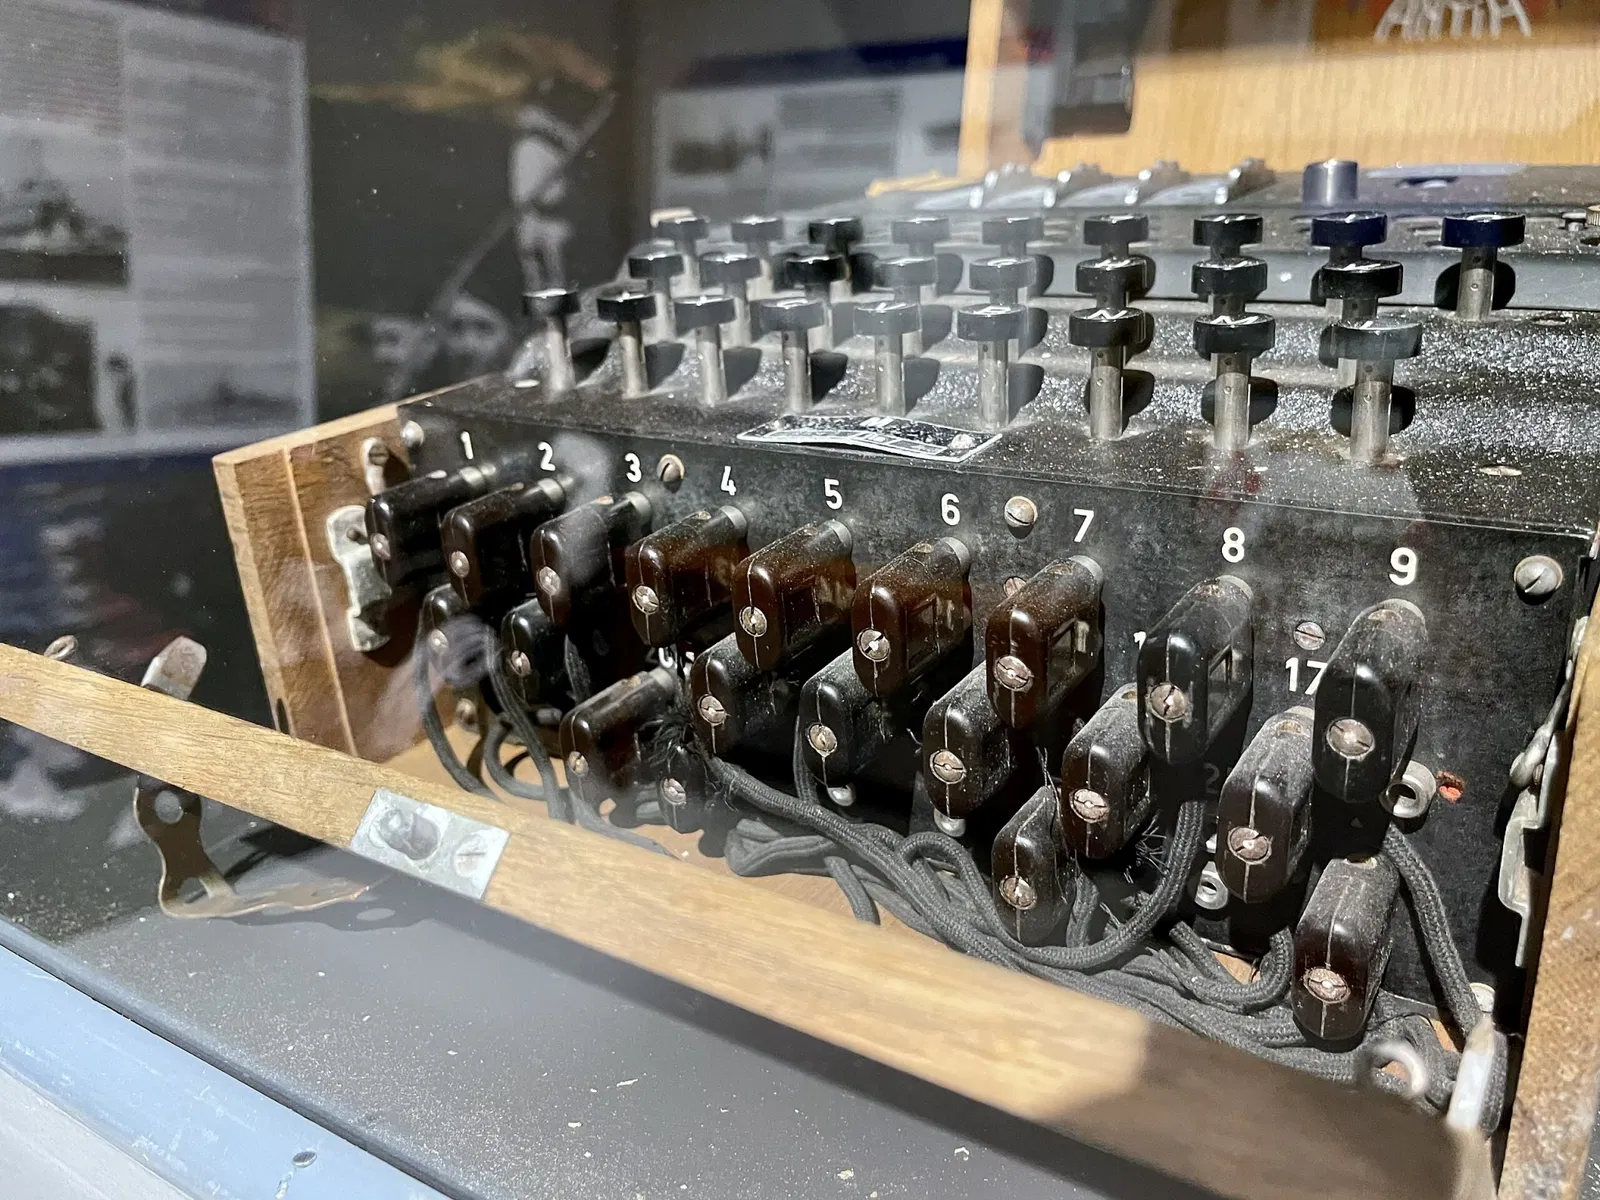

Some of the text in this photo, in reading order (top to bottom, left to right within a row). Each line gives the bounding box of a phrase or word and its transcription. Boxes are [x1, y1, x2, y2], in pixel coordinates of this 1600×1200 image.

[460, 431, 474, 460] 1
[537, 441, 556, 472] 2
[624, 452, 642, 483] 3
[720, 465, 737, 496] 4
[823, 478, 843, 510] 5
[941, 493, 961, 526] 6
[1073, 508, 1095, 543] 7
[1221, 526, 1246, 563] 8
[1388, 547, 1418, 586] 9
[1285, 656, 1329, 696] 17
